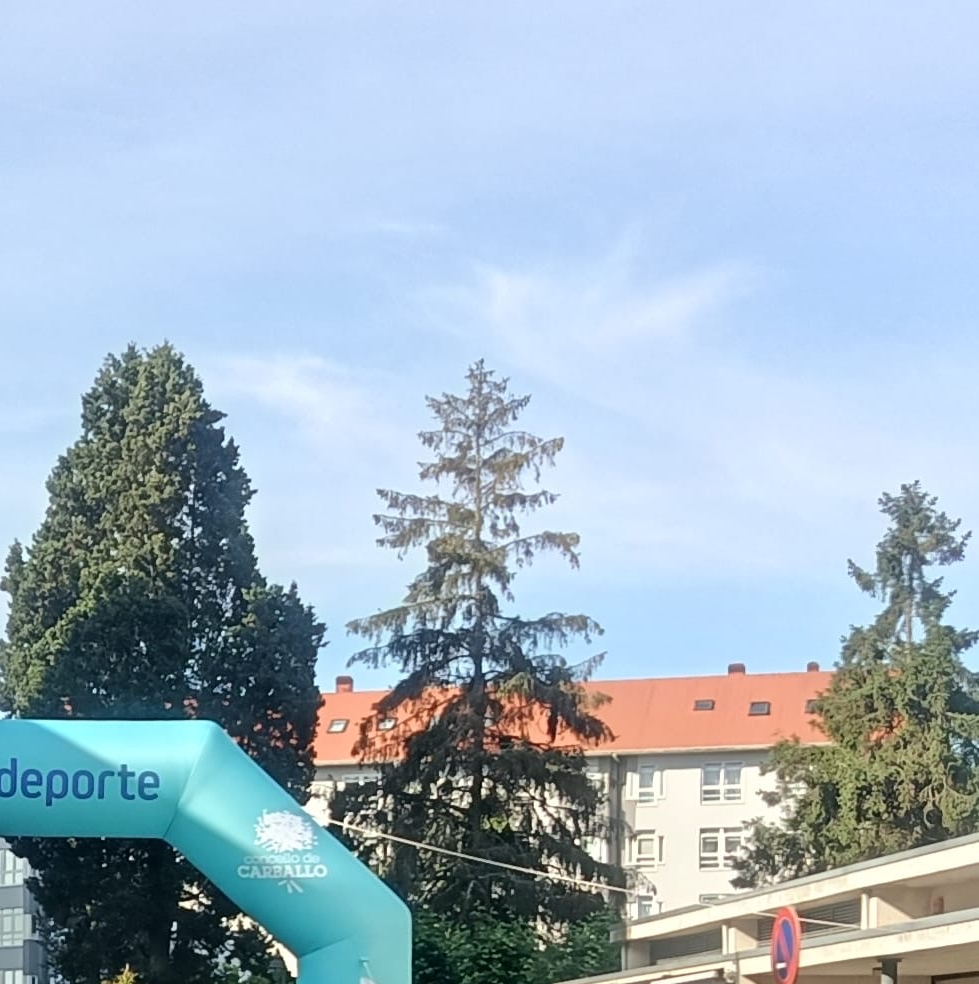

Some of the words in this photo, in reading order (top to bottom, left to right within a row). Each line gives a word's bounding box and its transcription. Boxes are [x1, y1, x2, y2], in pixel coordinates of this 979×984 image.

[244, 853, 300, 864] concello
[302, 853, 321, 863] de
[237, 864, 328, 878] CARBALLO
